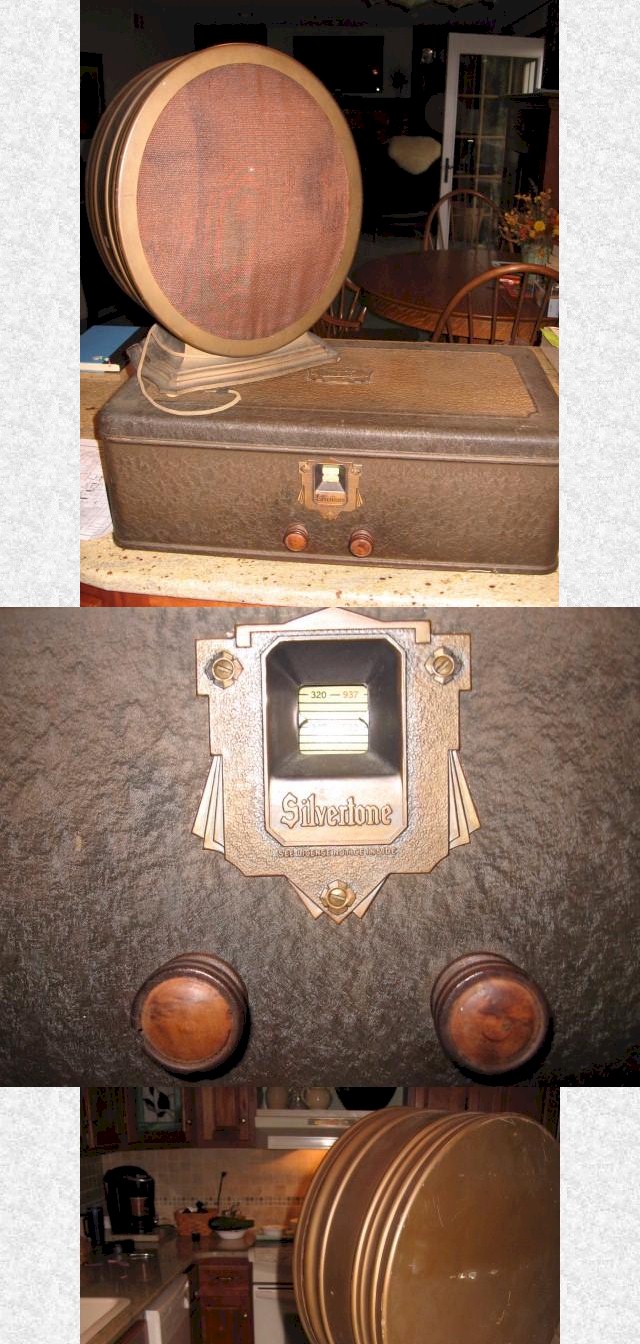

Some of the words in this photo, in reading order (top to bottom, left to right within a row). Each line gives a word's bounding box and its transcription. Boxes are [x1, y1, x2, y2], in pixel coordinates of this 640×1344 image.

[311, 691, 327, 699] 320
[343, 691, 359, 699] 937
[281, 792, 393, 829] Silvertone
